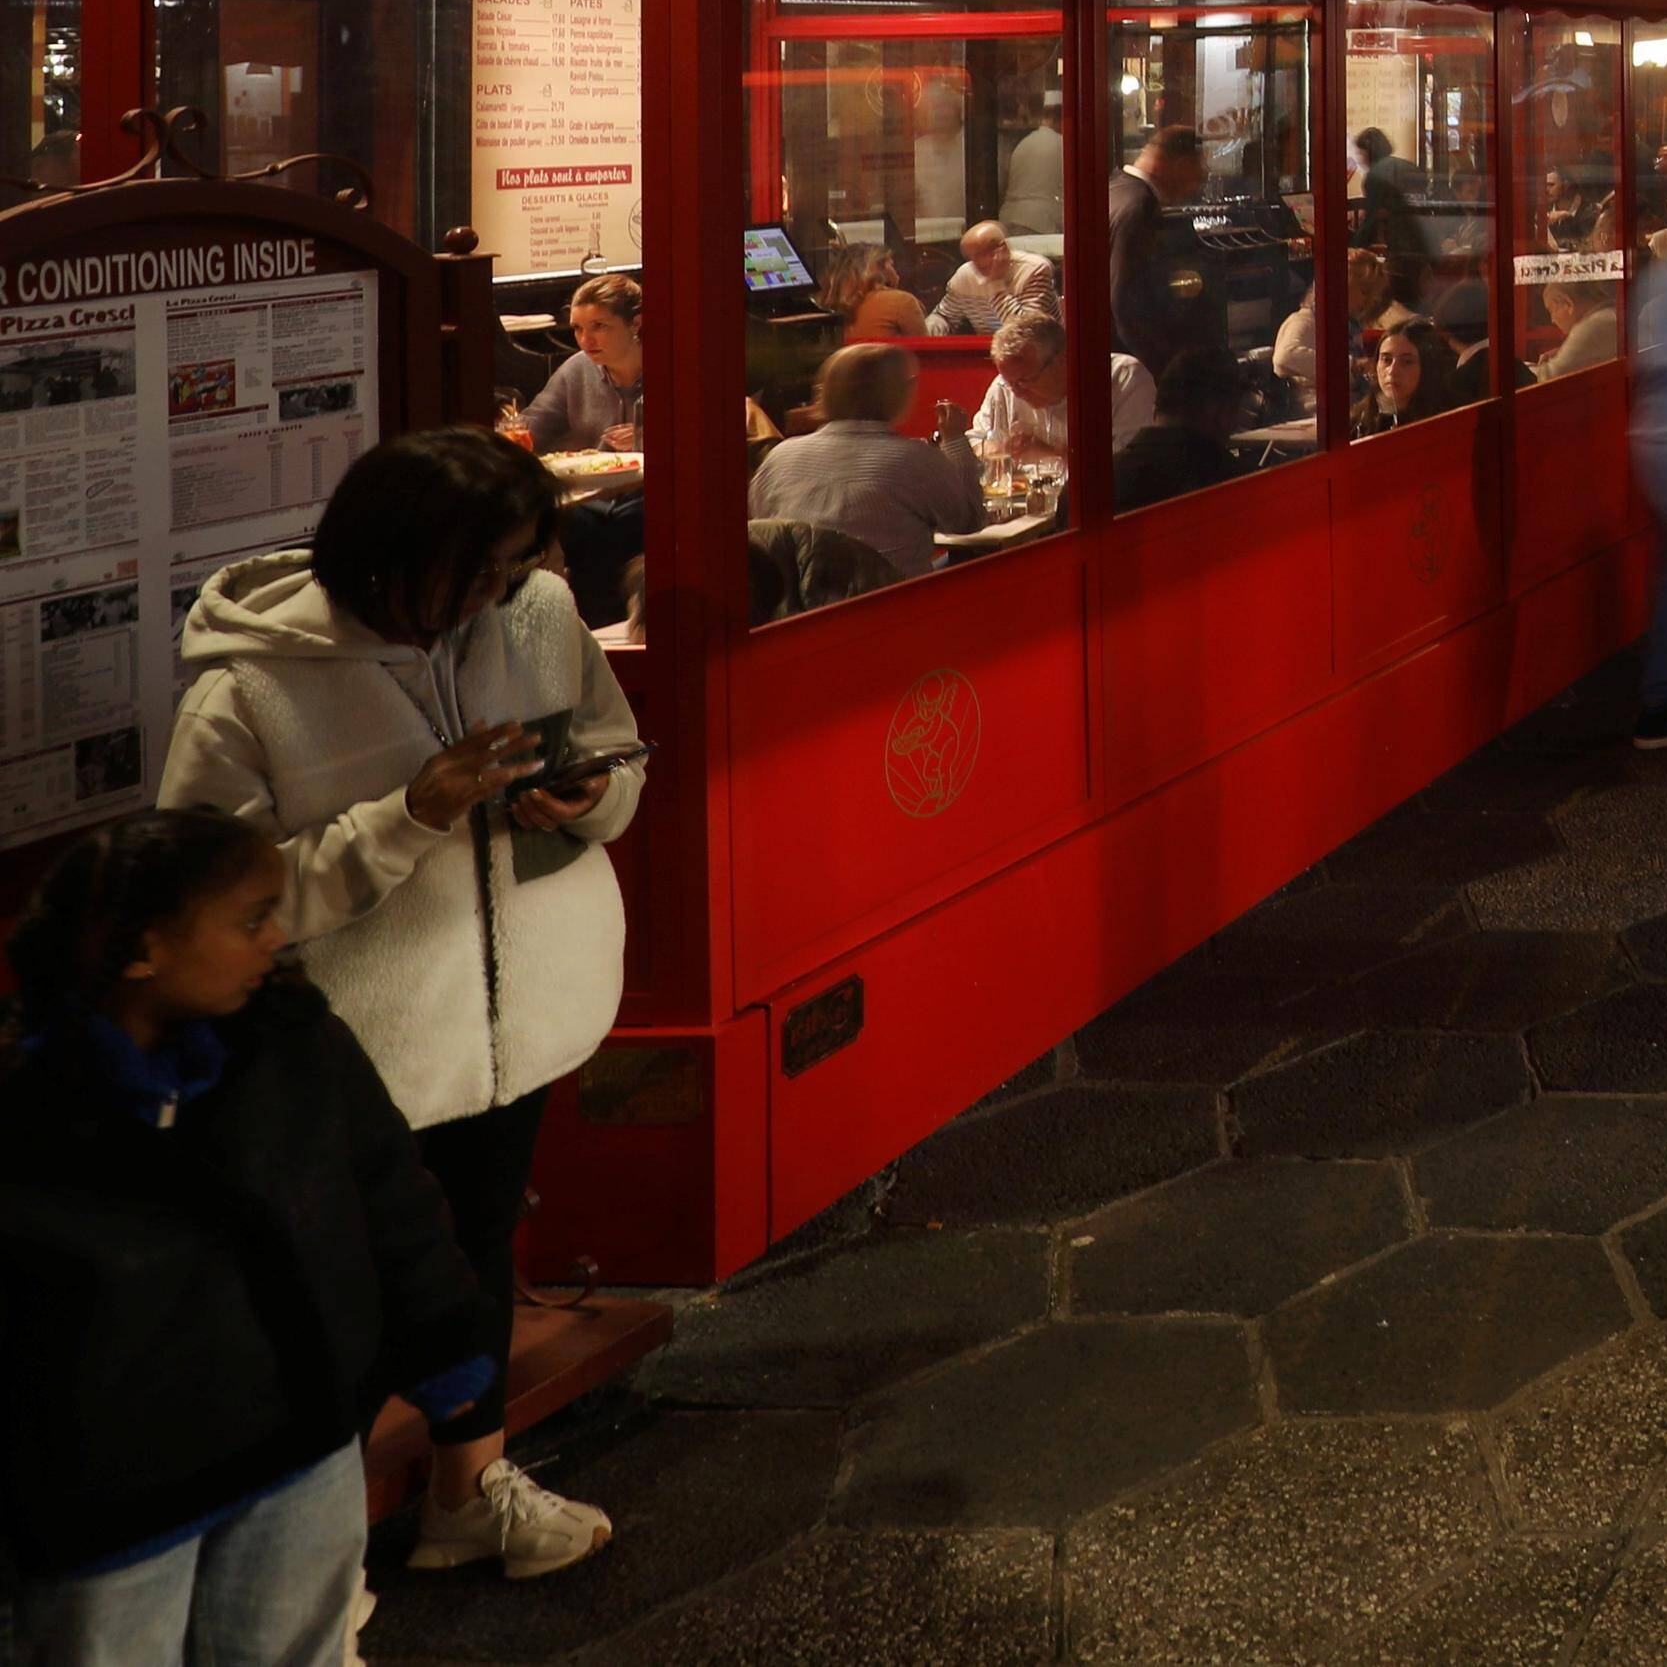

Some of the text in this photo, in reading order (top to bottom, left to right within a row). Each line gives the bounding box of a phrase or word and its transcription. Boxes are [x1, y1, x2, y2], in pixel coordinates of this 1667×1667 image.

[476, 84, 512, 96] PLATS
[501, 166, 628, 188] Nos plats sont à emporter
[522, 194, 566, 205] DESSERTS
[576, 191, 609, 202] GLACES
[17, 244, 225, 304] CONDITIONING
[233, 238, 316, 282] INSIDE
[1, 304, 136, 334] Pizza Cresci
